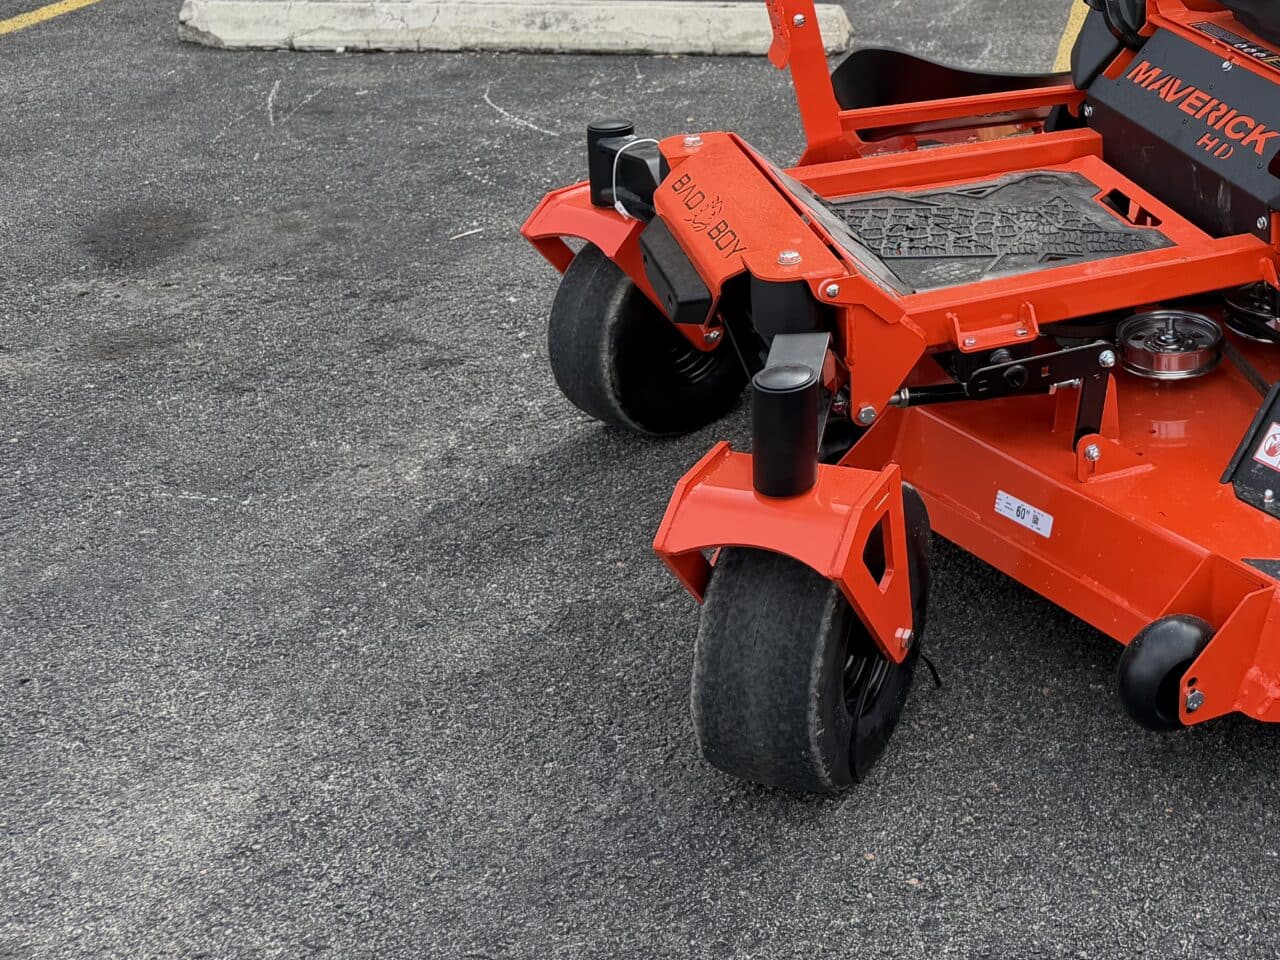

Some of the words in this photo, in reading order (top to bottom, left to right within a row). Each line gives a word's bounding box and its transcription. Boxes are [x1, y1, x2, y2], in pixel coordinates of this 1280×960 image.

[1126, 59, 1280, 155] MAVERICK
[1195, 132, 1235, 161] HD
[671, 173, 706, 211] BAD
[707, 219, 748, 259] BOY
[1015, 505, 1026, 520] 60
